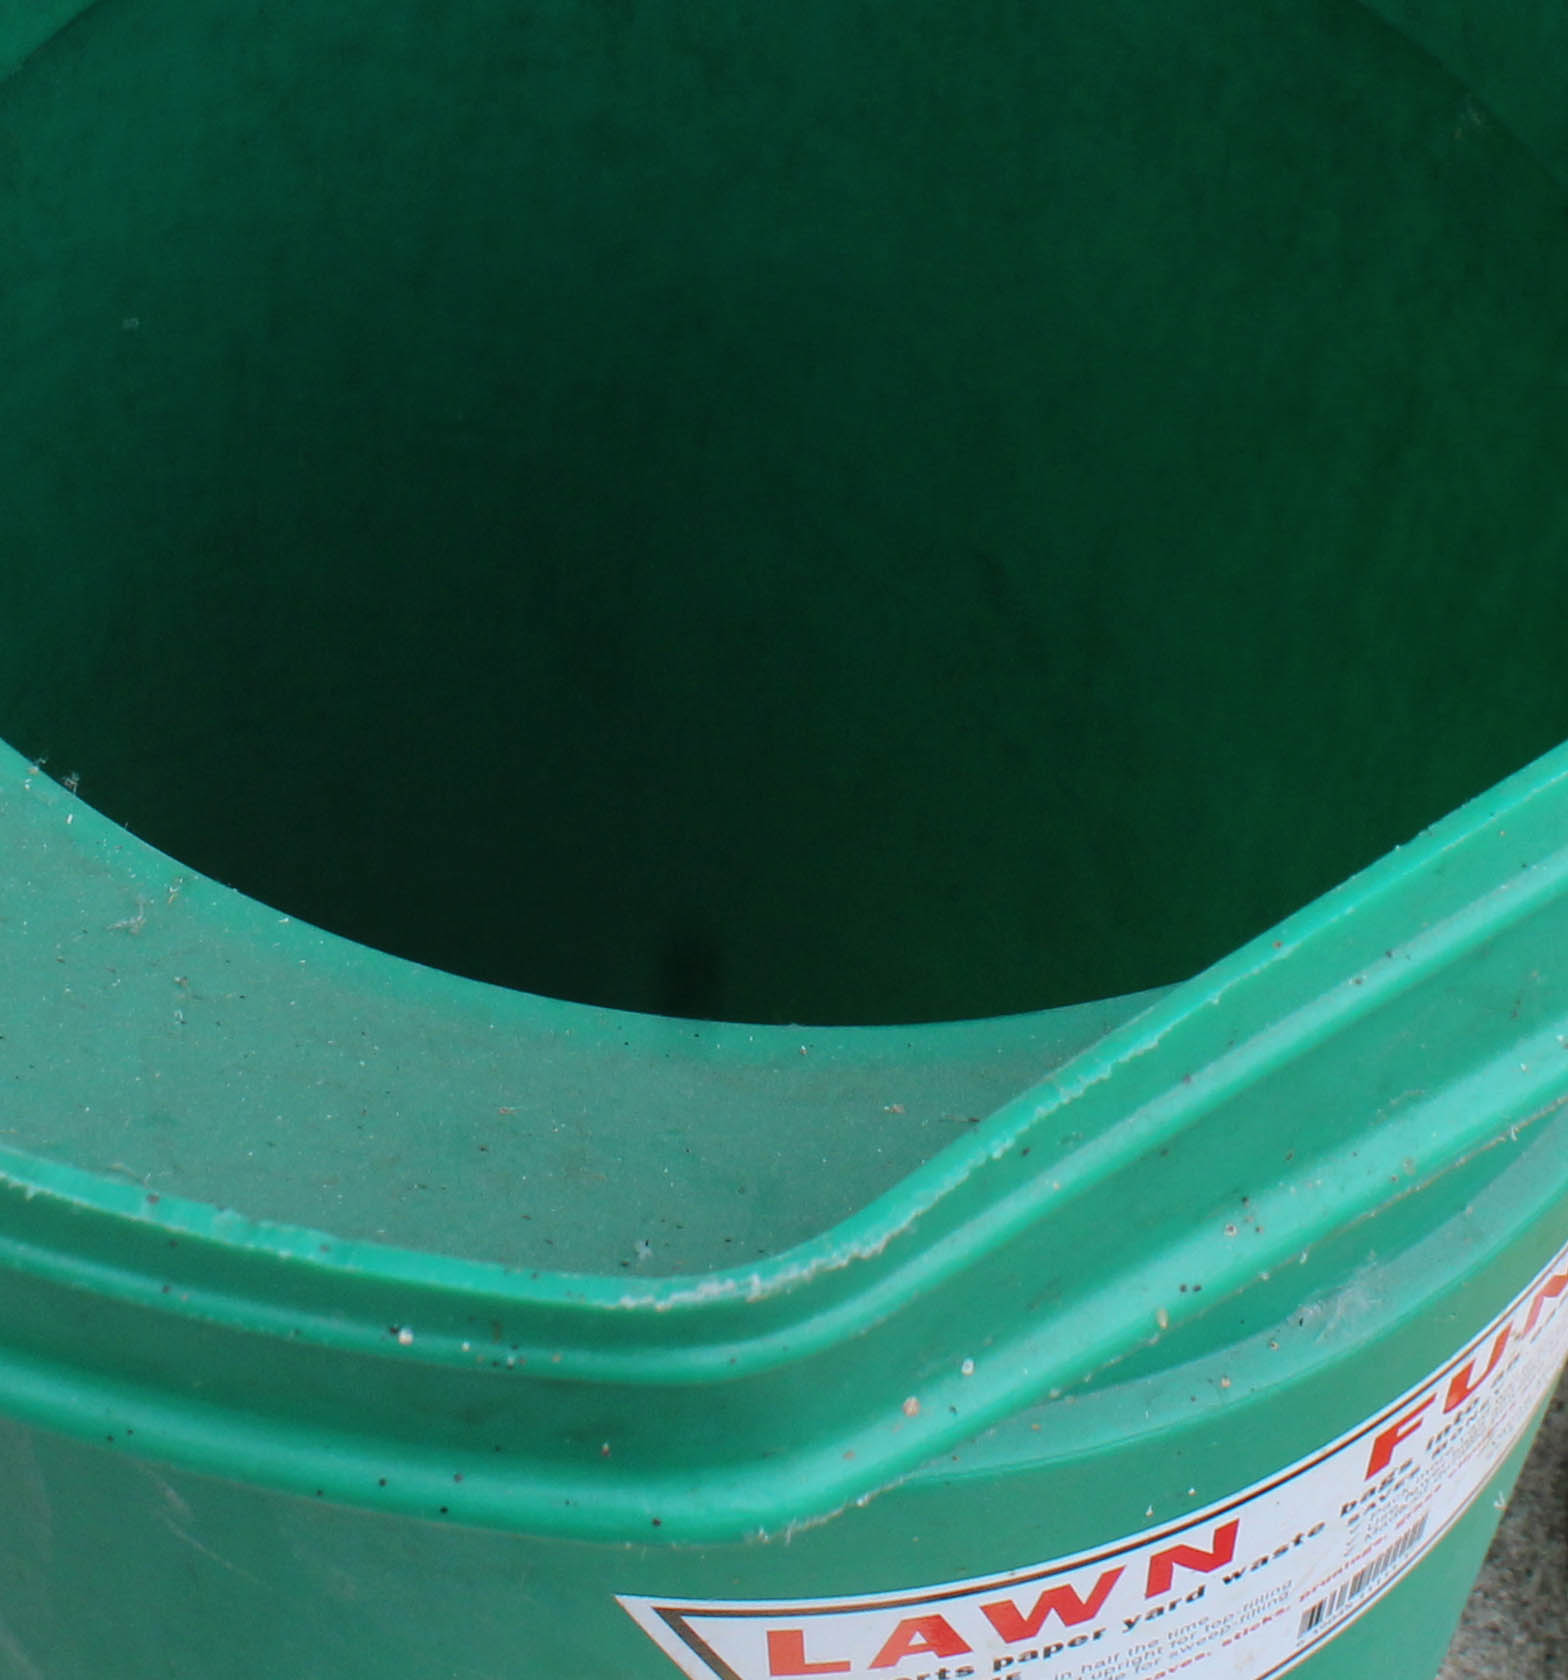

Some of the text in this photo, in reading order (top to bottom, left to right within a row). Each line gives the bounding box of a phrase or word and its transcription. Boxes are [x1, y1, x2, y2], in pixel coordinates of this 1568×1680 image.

[766, 1517, 1240, 1677] LAWN
[993, 1627, 1107, 1672] paper
[1122, 1584, 1206, 1633] yard
[1223, 1522, 1325, 1584] waste
[1340, 1458, 1413, 1517] bags
[1081, 1653, 1120, 1674] half
[1128, 1639, 1160, 1656] the
[1168, 1617, 1209, 1639] time
